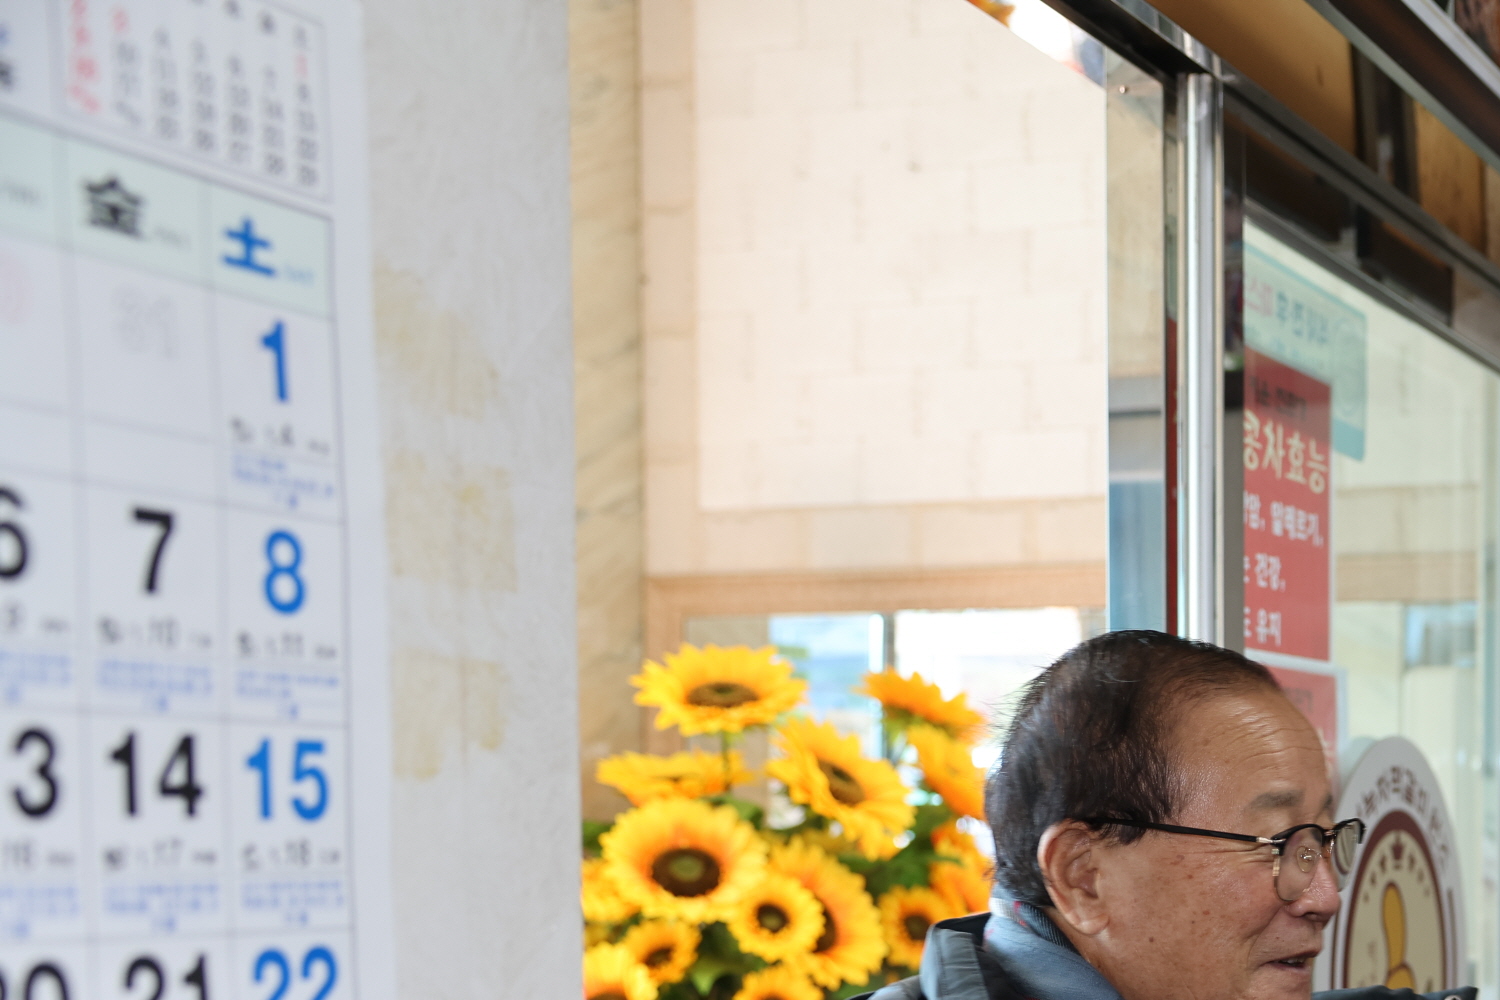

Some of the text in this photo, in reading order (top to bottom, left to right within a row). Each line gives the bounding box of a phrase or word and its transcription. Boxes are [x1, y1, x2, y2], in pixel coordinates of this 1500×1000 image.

[222, 216, 278, 278] 土
[260, 320, 289, 403] 1
[130, 506, 176, 597] 7
[264, 529, 307, 616] 8
[1256, 608, 1282, 648] 유지
[111, 729, 204, 820] 14
[246, 737, 330, 821] 15
